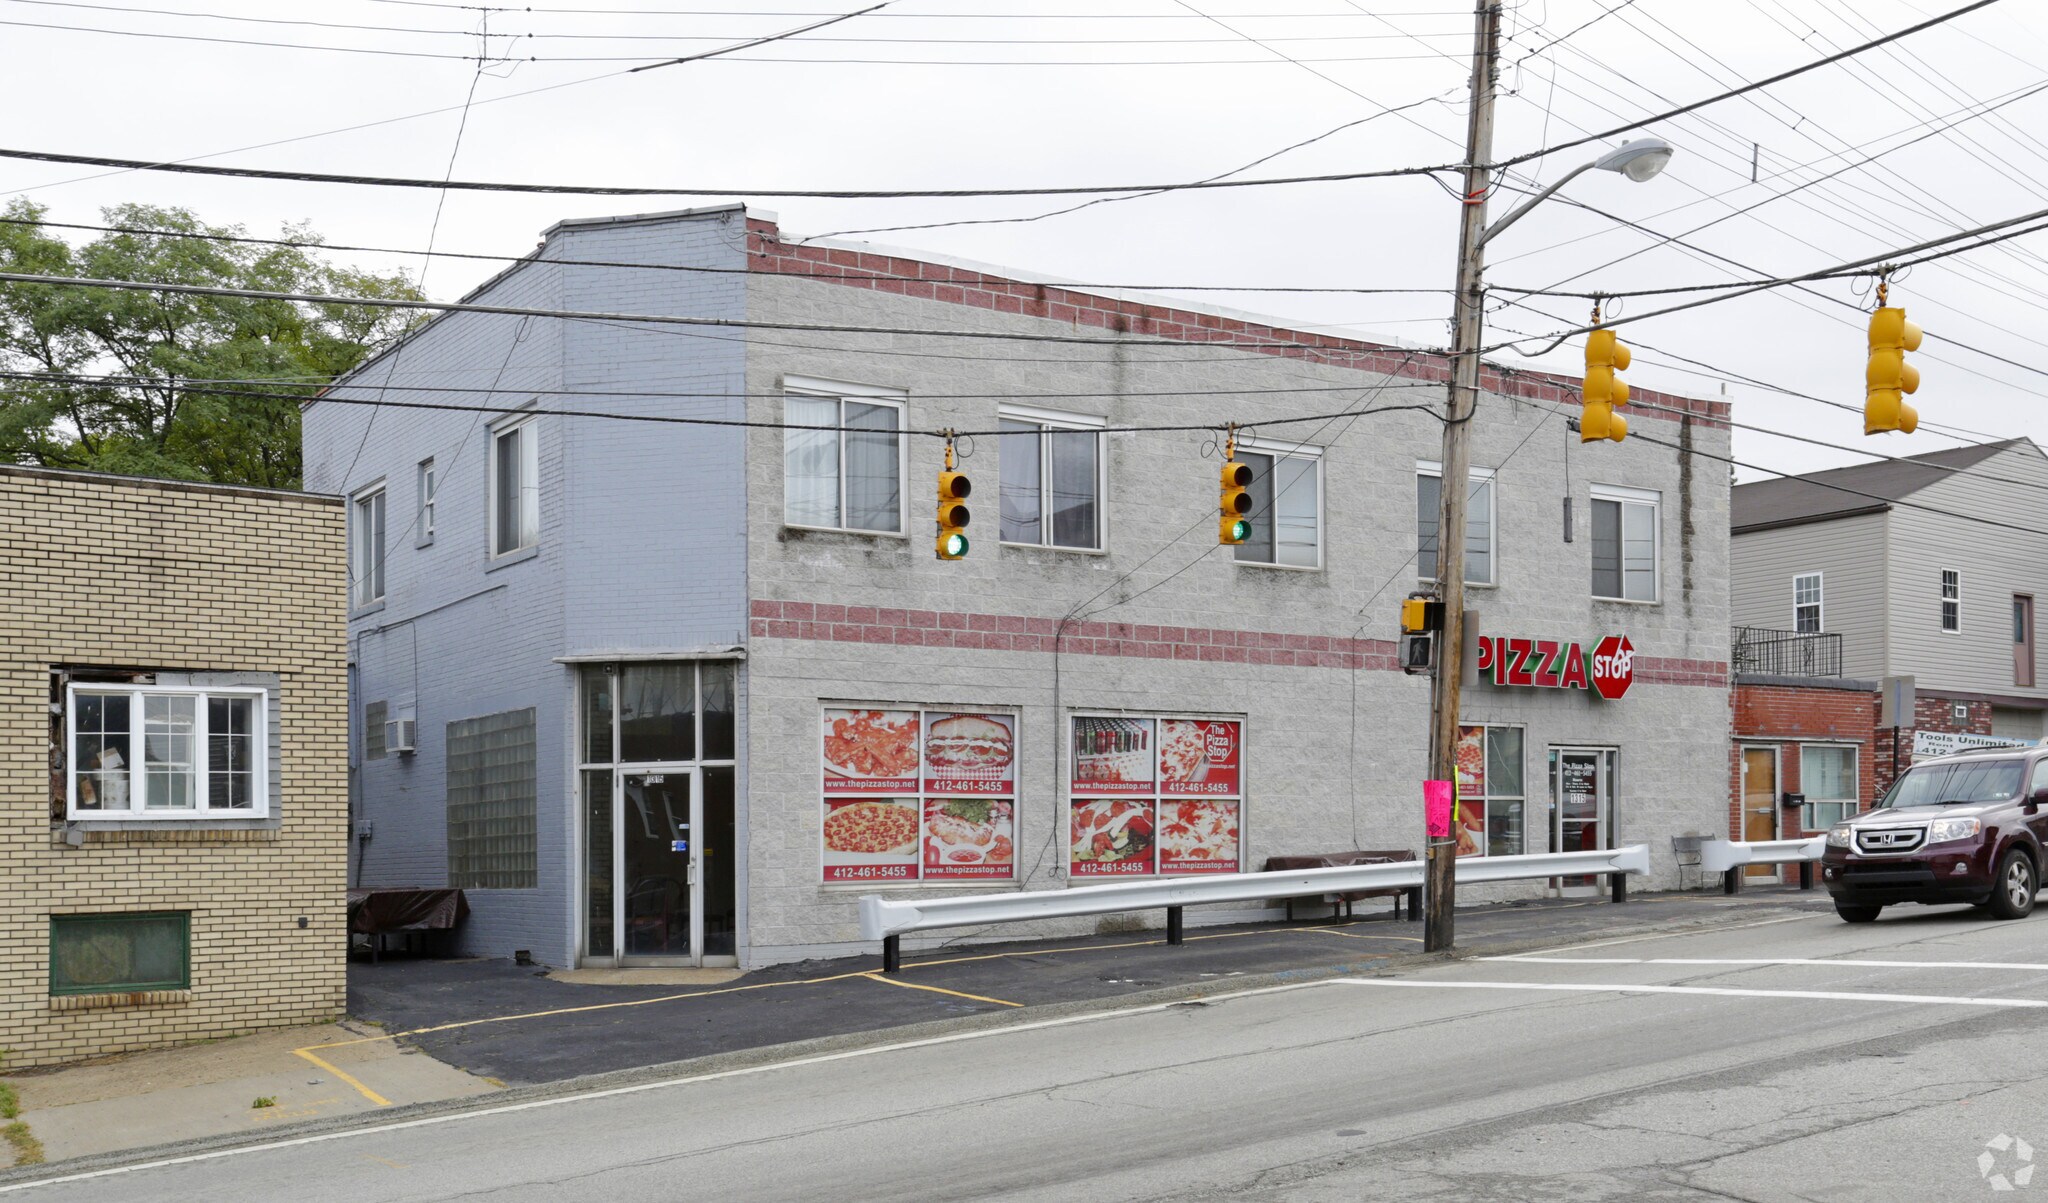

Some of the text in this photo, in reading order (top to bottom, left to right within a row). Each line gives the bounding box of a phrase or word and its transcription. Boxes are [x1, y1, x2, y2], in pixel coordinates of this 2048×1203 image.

[1479, 636, 1633, 689] PIZZA STOP
[1211, 724, 1225, 735] The
[1206, 734, 1229, 746] Pizza
[1918, 732, 1953, 742] Tools
[1207, 745, 1228, 759] Stop
[825, 780, 915, 789] www.thepizzastop.net
[933, 780, 1003, 792] 412-461-5455
[1073, 782, 1151, 791] www.thepizzastop.net
[1169, 783, 1229, 793] 412-461-5455
[924, 865, 1010, 874] www.thepizzastop.net
[1080, 863, 1143, 873] 412-461-5455
[1162, 862, 1235, 870] www.thepizzastop.net
[833, 866, 907, 877] 412-461-5455
